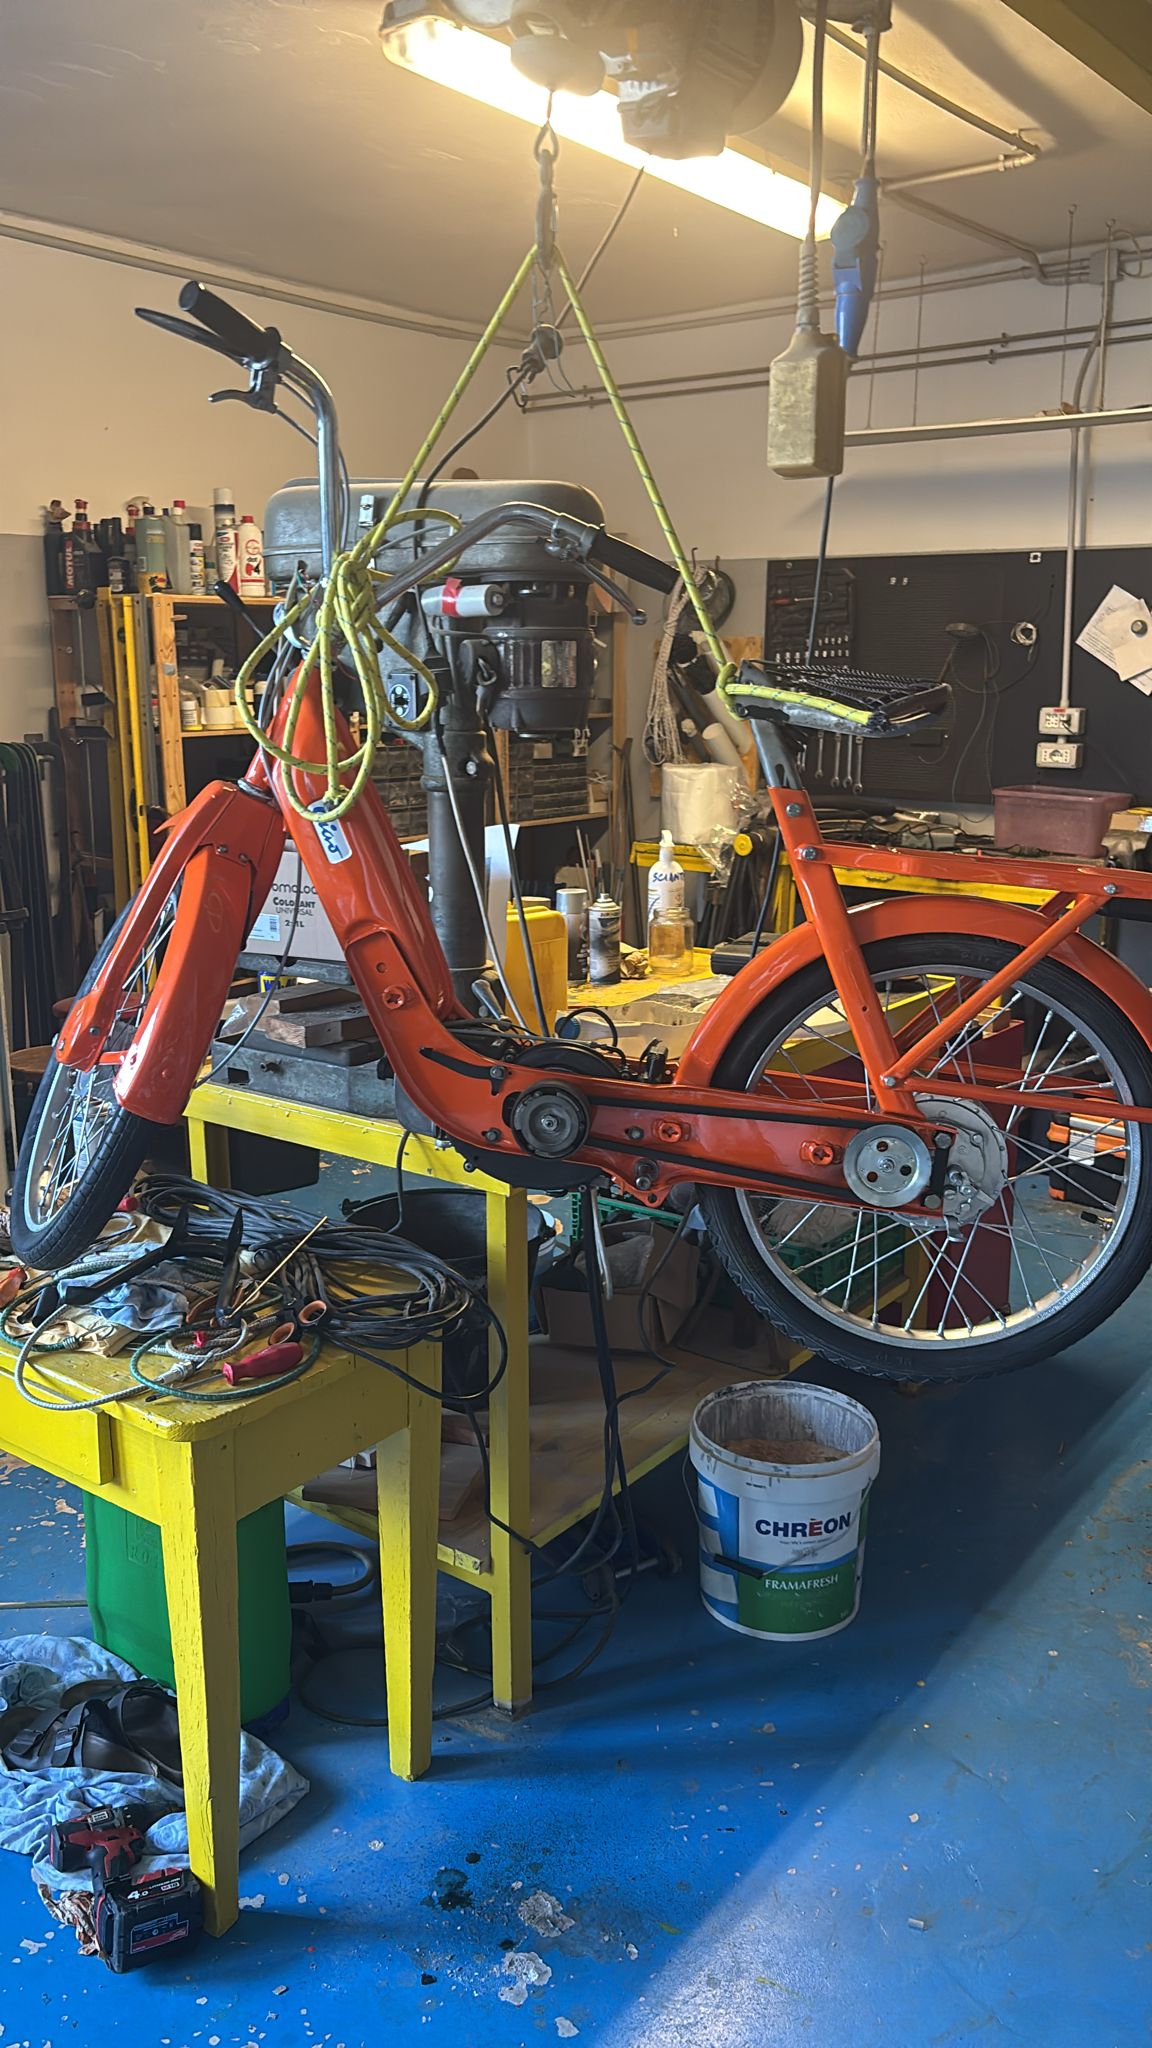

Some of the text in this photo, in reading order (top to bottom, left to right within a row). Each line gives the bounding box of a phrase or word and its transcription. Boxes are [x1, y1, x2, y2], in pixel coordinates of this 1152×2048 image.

[65, 546, 75, 589] MOTUL
[273, 897, 316, 908] COLOANT
[276, 907, 314, 917] UNIVSAL
[765, 1574, 839, 1591] FRAMAFRESH
[127, 1890, 149, 1900] 4.0
